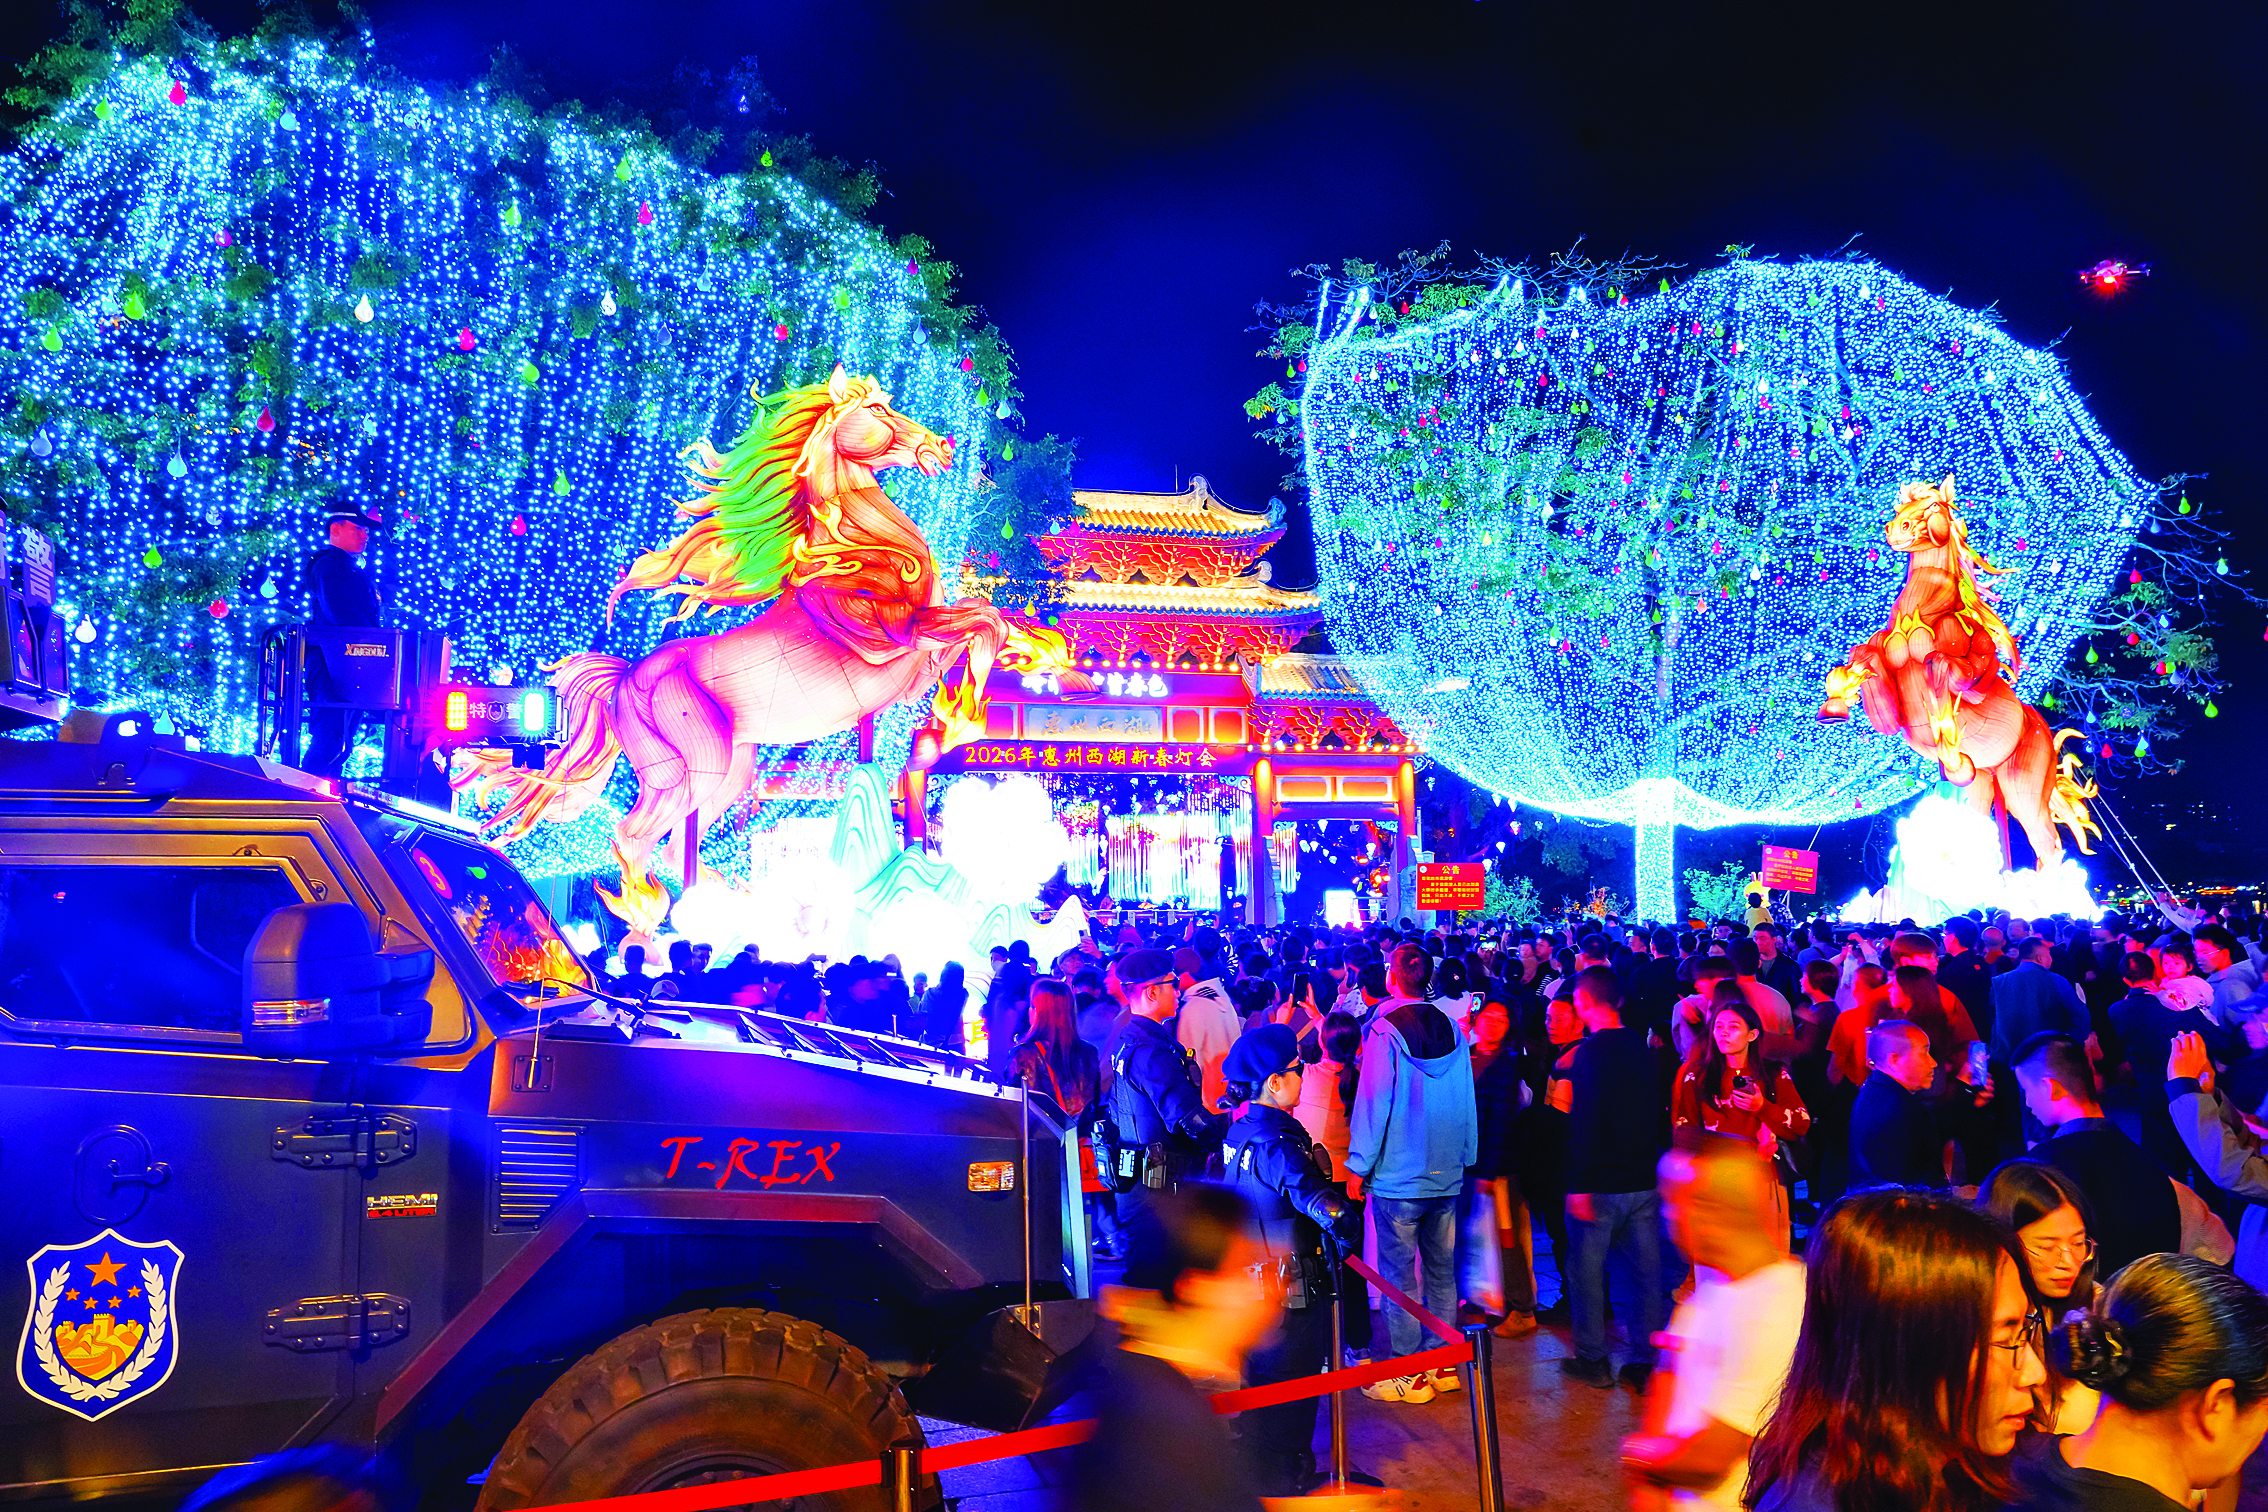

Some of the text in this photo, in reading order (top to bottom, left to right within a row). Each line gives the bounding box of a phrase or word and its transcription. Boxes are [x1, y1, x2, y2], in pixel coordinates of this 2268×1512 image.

[22, 526, 54, 604] 警
[1041, 711, 1146, 736] 惠州西湖
[964, 745, 1218, 768] 2026年惠州西湖新春灯会
[419, 856, 446, 891] 3
[1441, 865, 1460, 875] 公告
[660, 1136, 841, 1190] T-REX
[366, 1193, 438, 1208] HEMI
